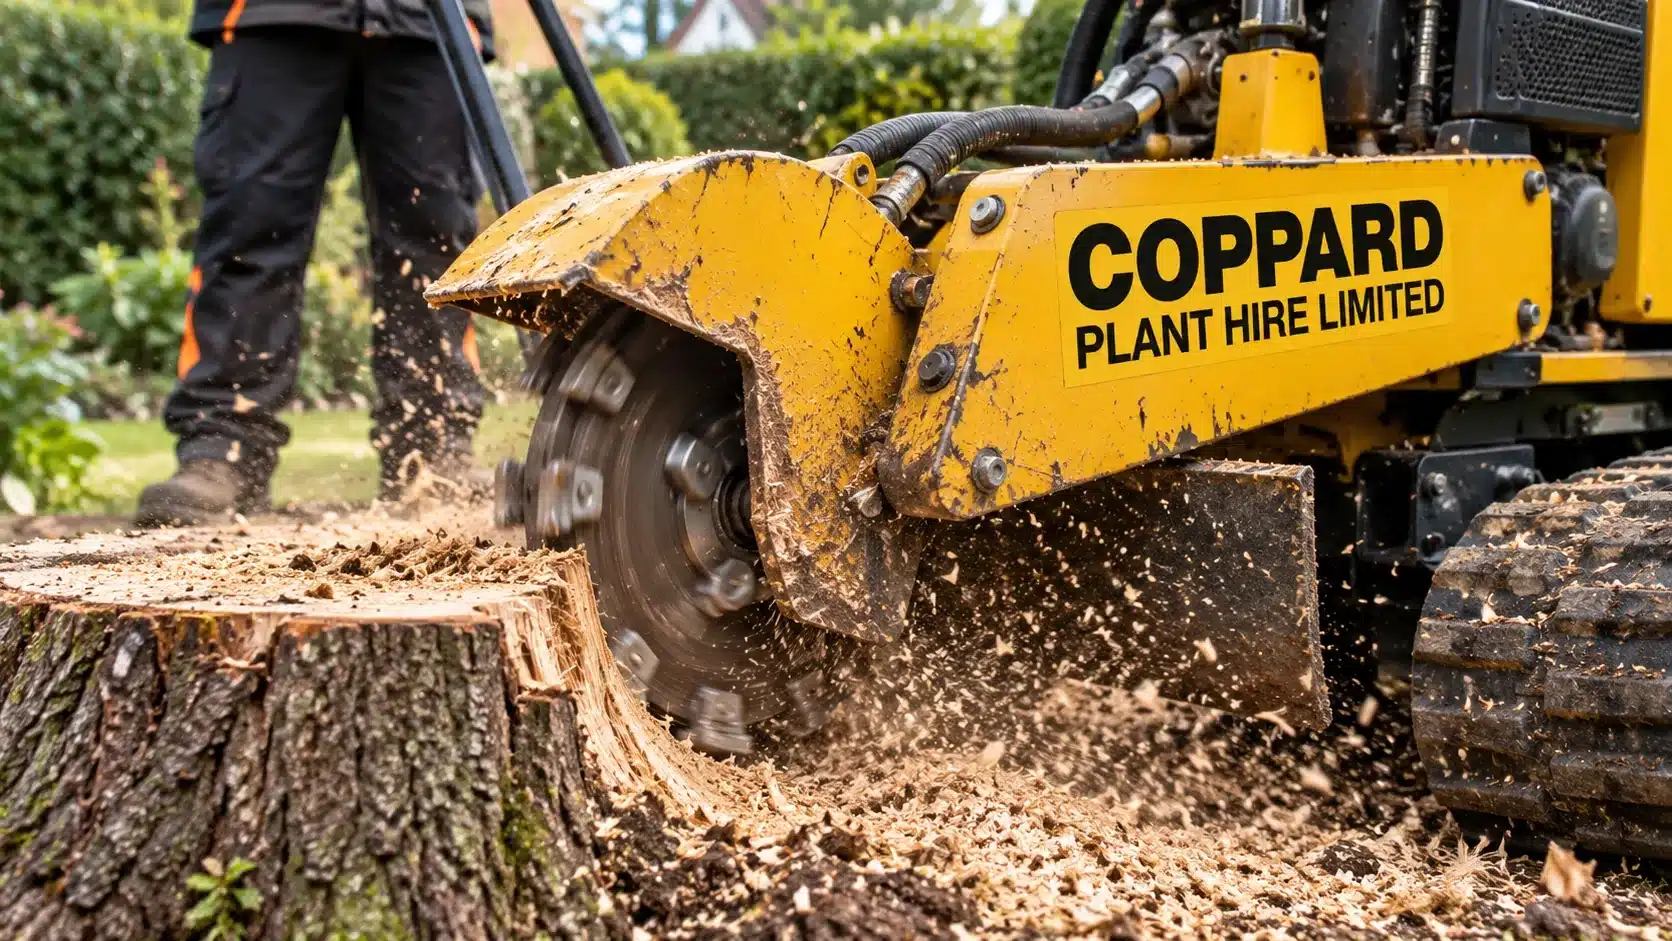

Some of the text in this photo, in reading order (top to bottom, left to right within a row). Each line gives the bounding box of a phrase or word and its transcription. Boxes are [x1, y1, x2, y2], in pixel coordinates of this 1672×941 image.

[1068, 199, 1444, 311] COPPARD
[1076, 278, 1445, 370] PLANT HIRE LIMITED
